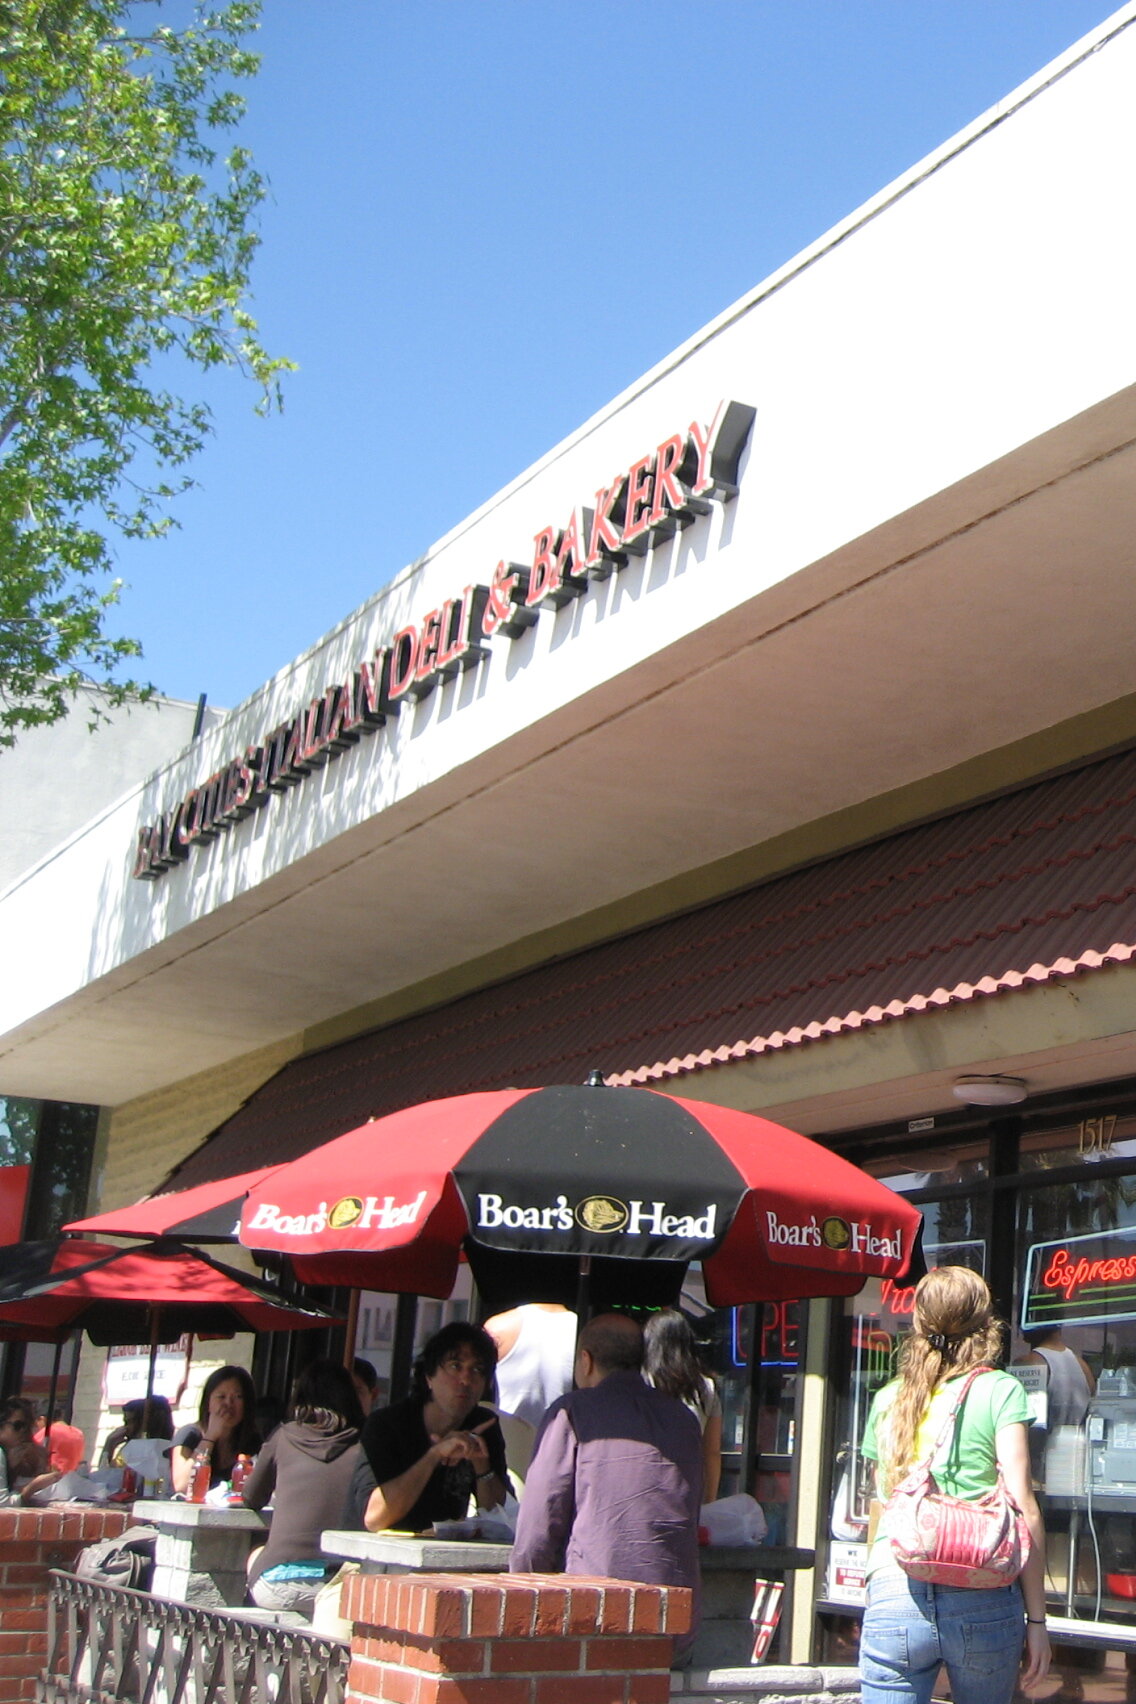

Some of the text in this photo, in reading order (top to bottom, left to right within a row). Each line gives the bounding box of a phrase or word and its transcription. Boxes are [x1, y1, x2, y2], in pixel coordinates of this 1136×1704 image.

[257, 648, 389, 793] ITALIAN
[388, 583, 477, 700] DELI
[482, 560, 519, 635] &
[526, 398, 726, 607] BAKERY
[1078, 1115, 1117, 1155] 1517
[247, 1191, 427, 1235] Boar's Head
[477, 1194, 717, 1239] Boar's Head
[766, 1211, 902, 1260] Boar's Head
